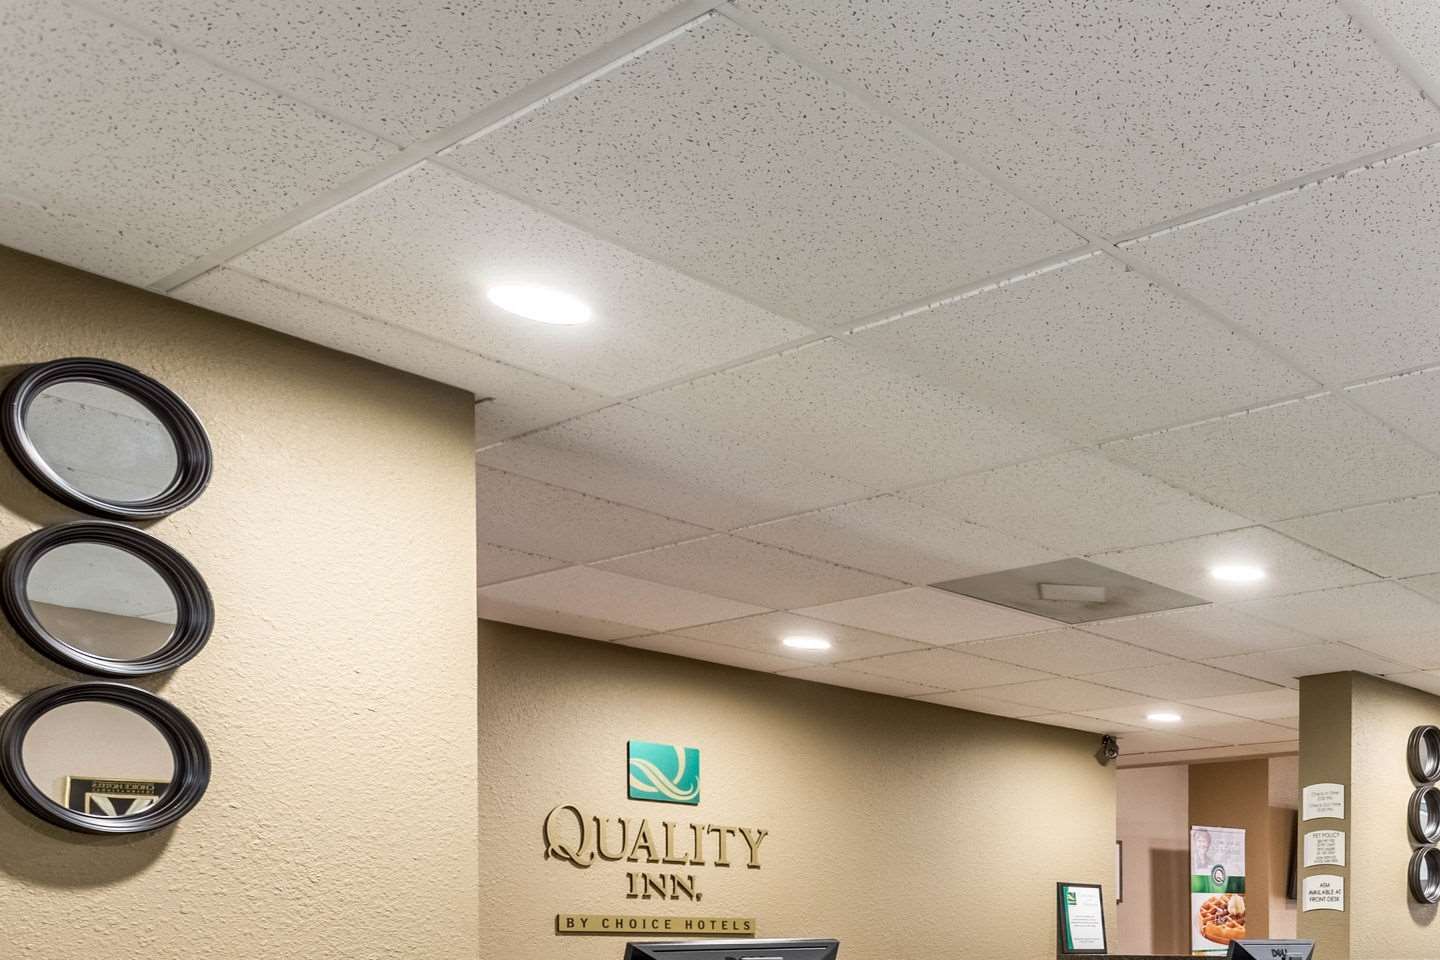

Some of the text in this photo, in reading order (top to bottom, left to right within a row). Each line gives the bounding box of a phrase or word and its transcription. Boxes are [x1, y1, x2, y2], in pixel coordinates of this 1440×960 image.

[542, 803, 769, 870] QUALITY
[566, 917, 752, 931] BY CHOICE HOTELS
